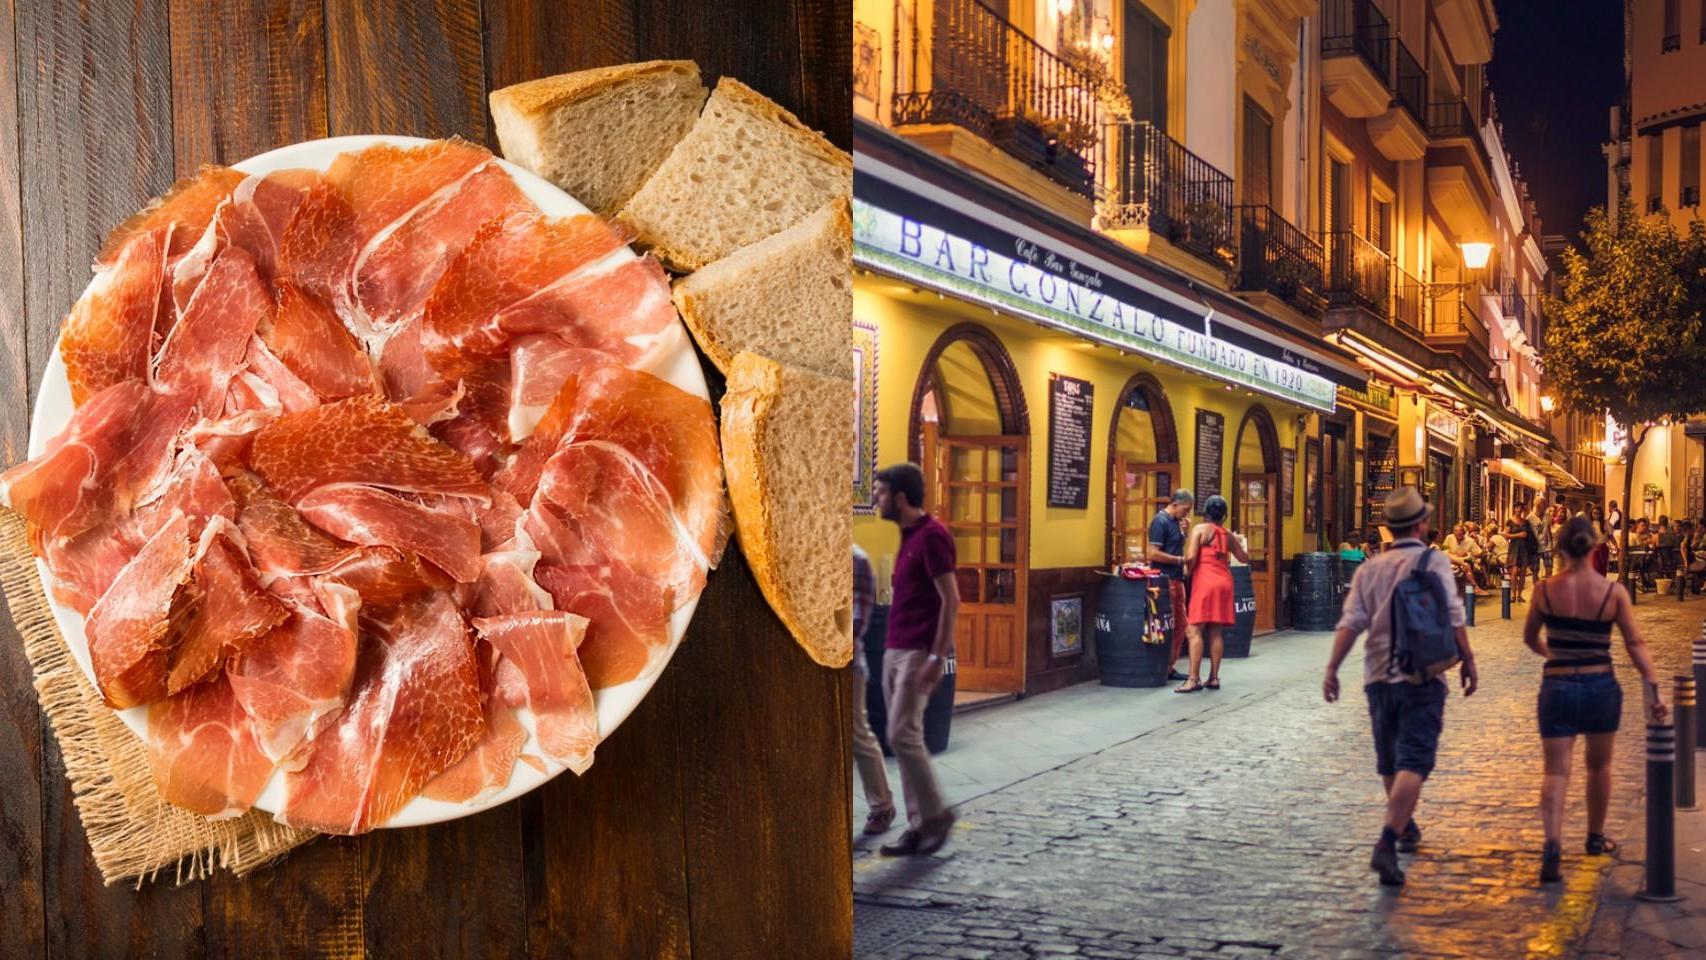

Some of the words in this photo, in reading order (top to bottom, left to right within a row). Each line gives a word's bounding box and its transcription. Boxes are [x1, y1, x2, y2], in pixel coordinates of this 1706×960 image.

[899, 214, 993, 283] BAR
[1007, 260, 1165, 342] GONZALO
[1177, 330, 1246, 372] FUNDADO
[1253, 358, 1270, 380] EN
[1274, 367, 1303, 391] 1920
[1044, 250, 1064, 274] Bar
